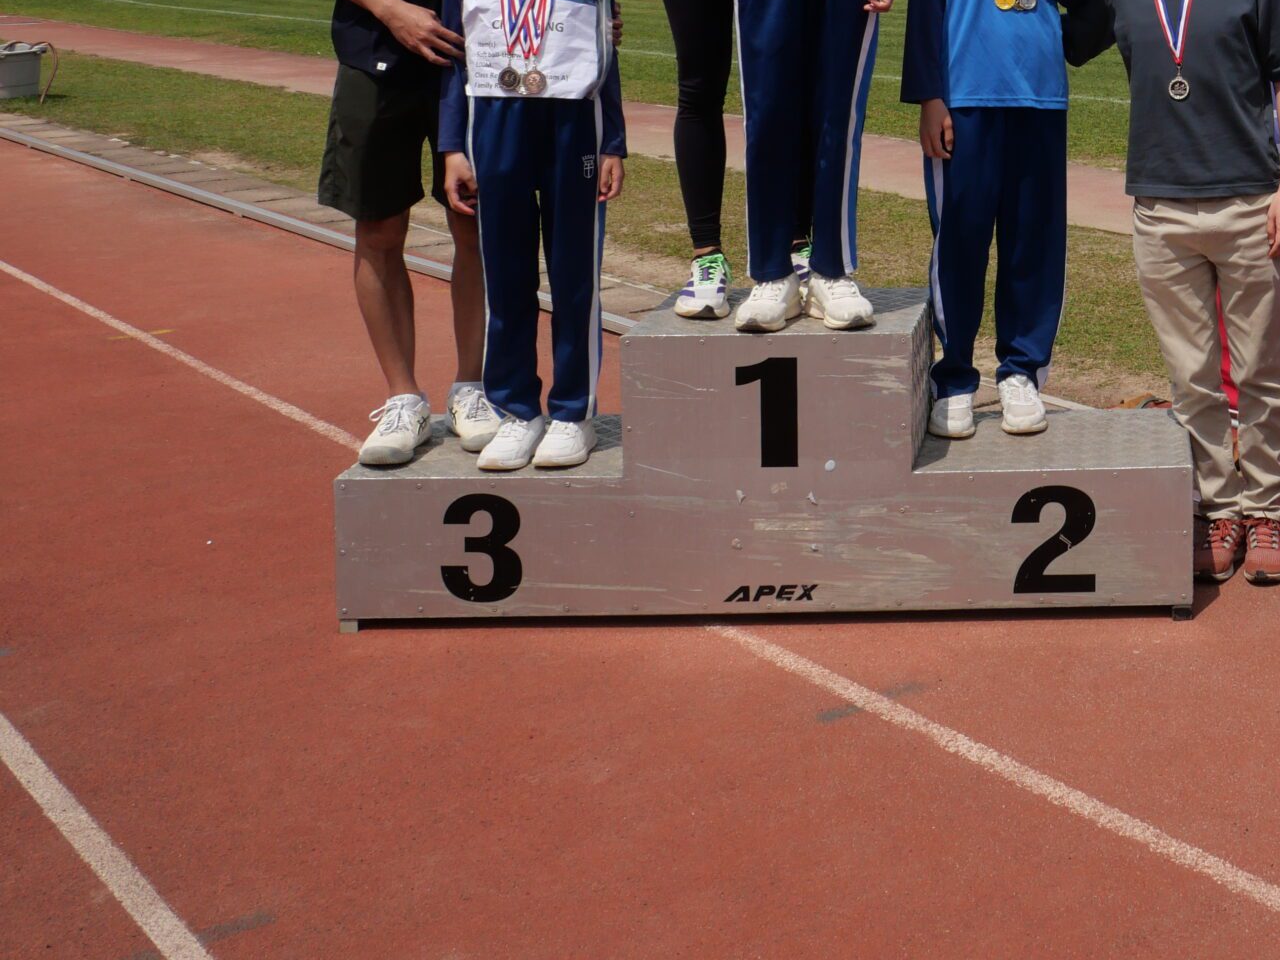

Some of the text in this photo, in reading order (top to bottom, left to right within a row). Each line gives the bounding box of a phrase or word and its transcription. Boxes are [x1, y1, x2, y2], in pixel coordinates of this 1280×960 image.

[735, 357, 799, 469] 1
[440, 493, 523, 603] 3
[723, 584, 818, 602] APEX
[1010, 485, 1097, 595] 2
